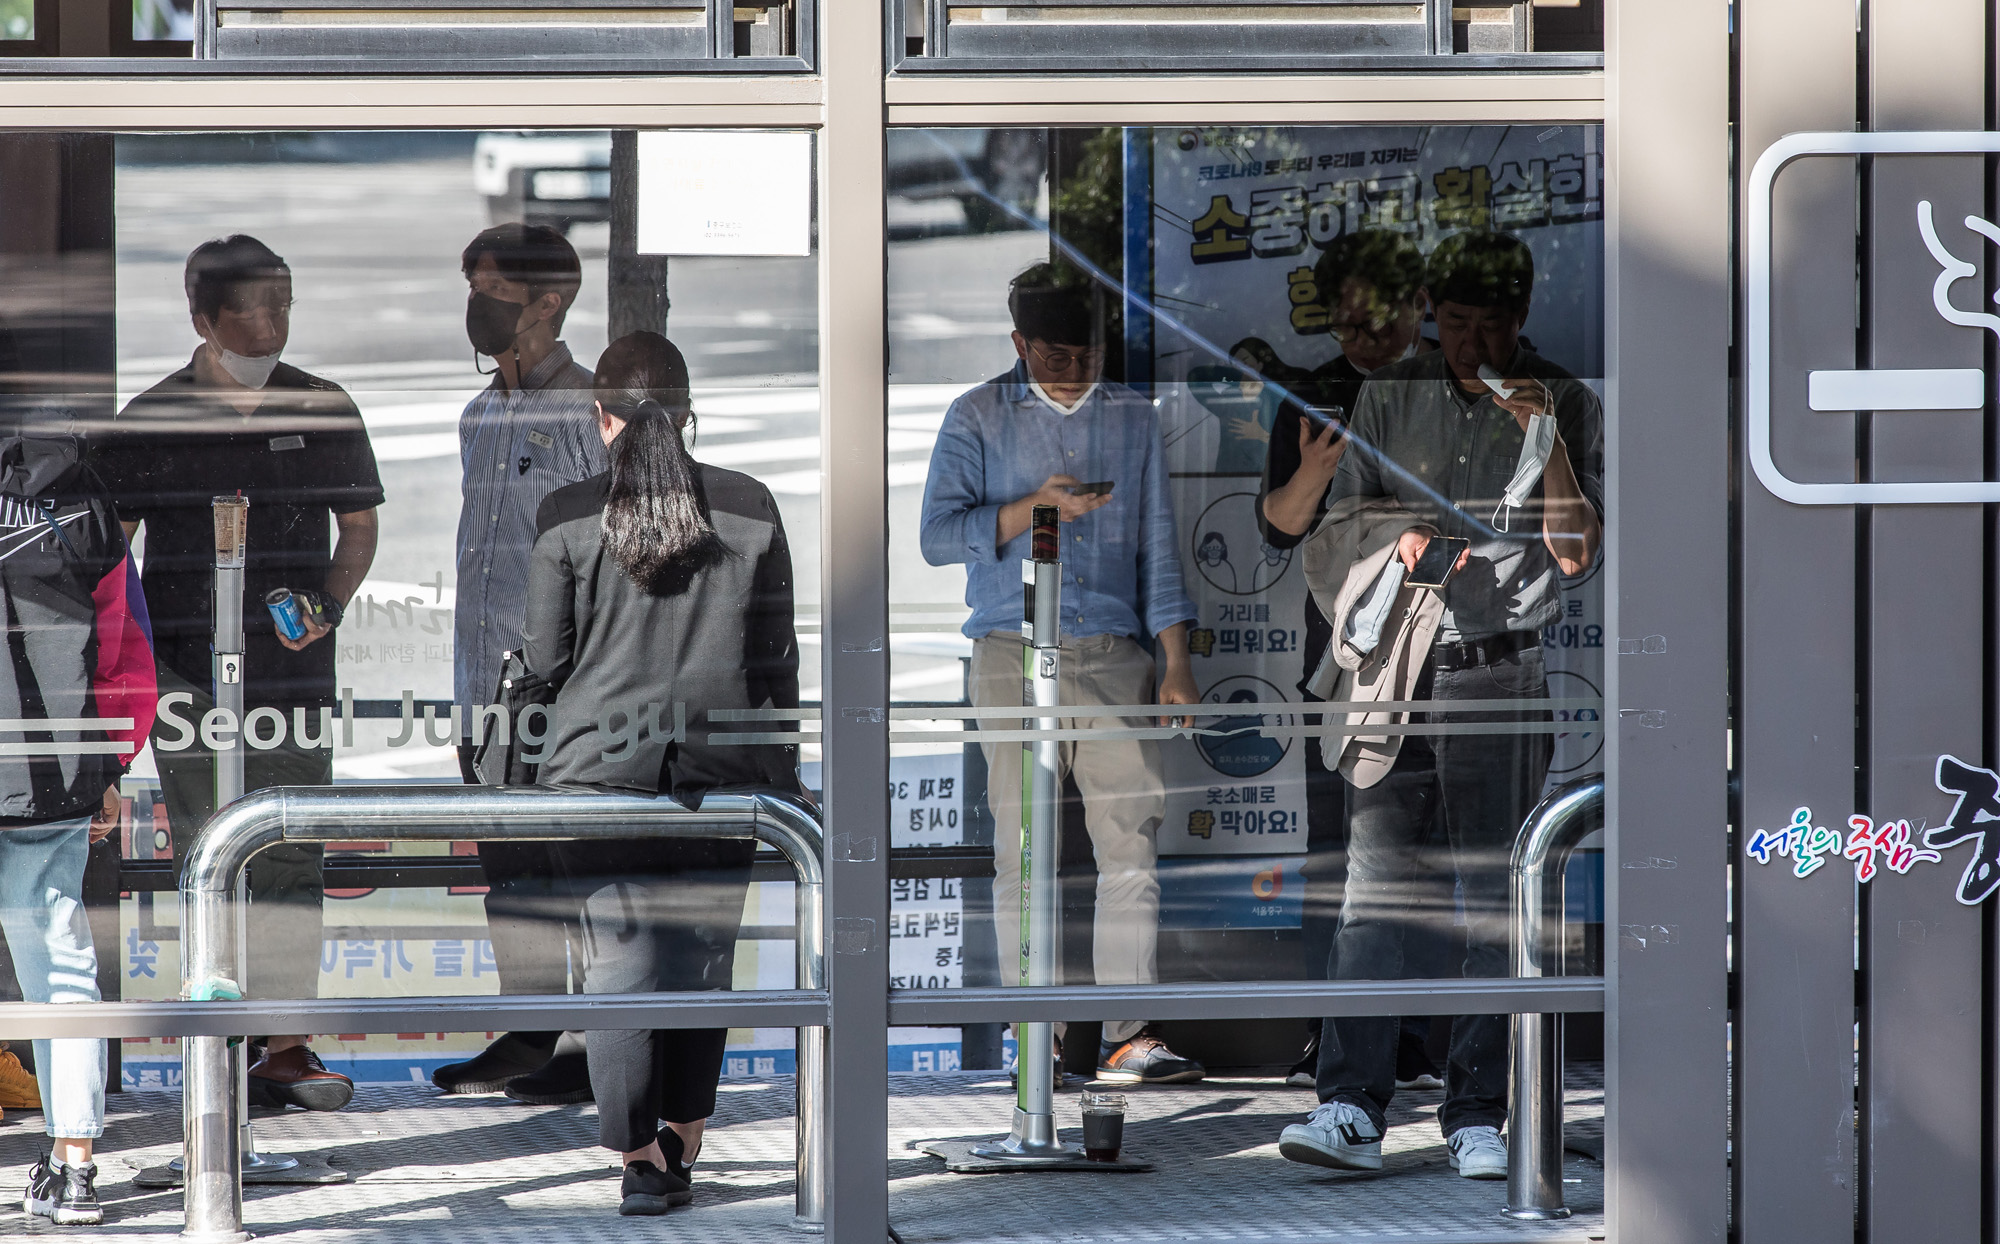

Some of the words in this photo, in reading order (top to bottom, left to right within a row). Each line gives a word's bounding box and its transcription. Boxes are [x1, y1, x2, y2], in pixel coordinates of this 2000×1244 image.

[1317, 151, 1366, 170] 우리를
[1370, 147, 1419, 166] 지키는
[1190, 174, 1422, 265] 소중하고
[1434, 153, 1604, 230] 확실한
[1218, 604, 1270, 622] 거리를
[1563, 600, 1584, 618] 로
[1220, 629, 1297, 653] 띄워요!
[155, 687, 355, 751] Seoul
[1207, 786, 1276, 805] 옷소매로
[1220, 810, 1297, 835] 막아요!
[1748, 808, 1841, 876] 서울의
[1846, 816, 1939, 881] 중심
[1252, 906, 1283, 916] 서울중구
